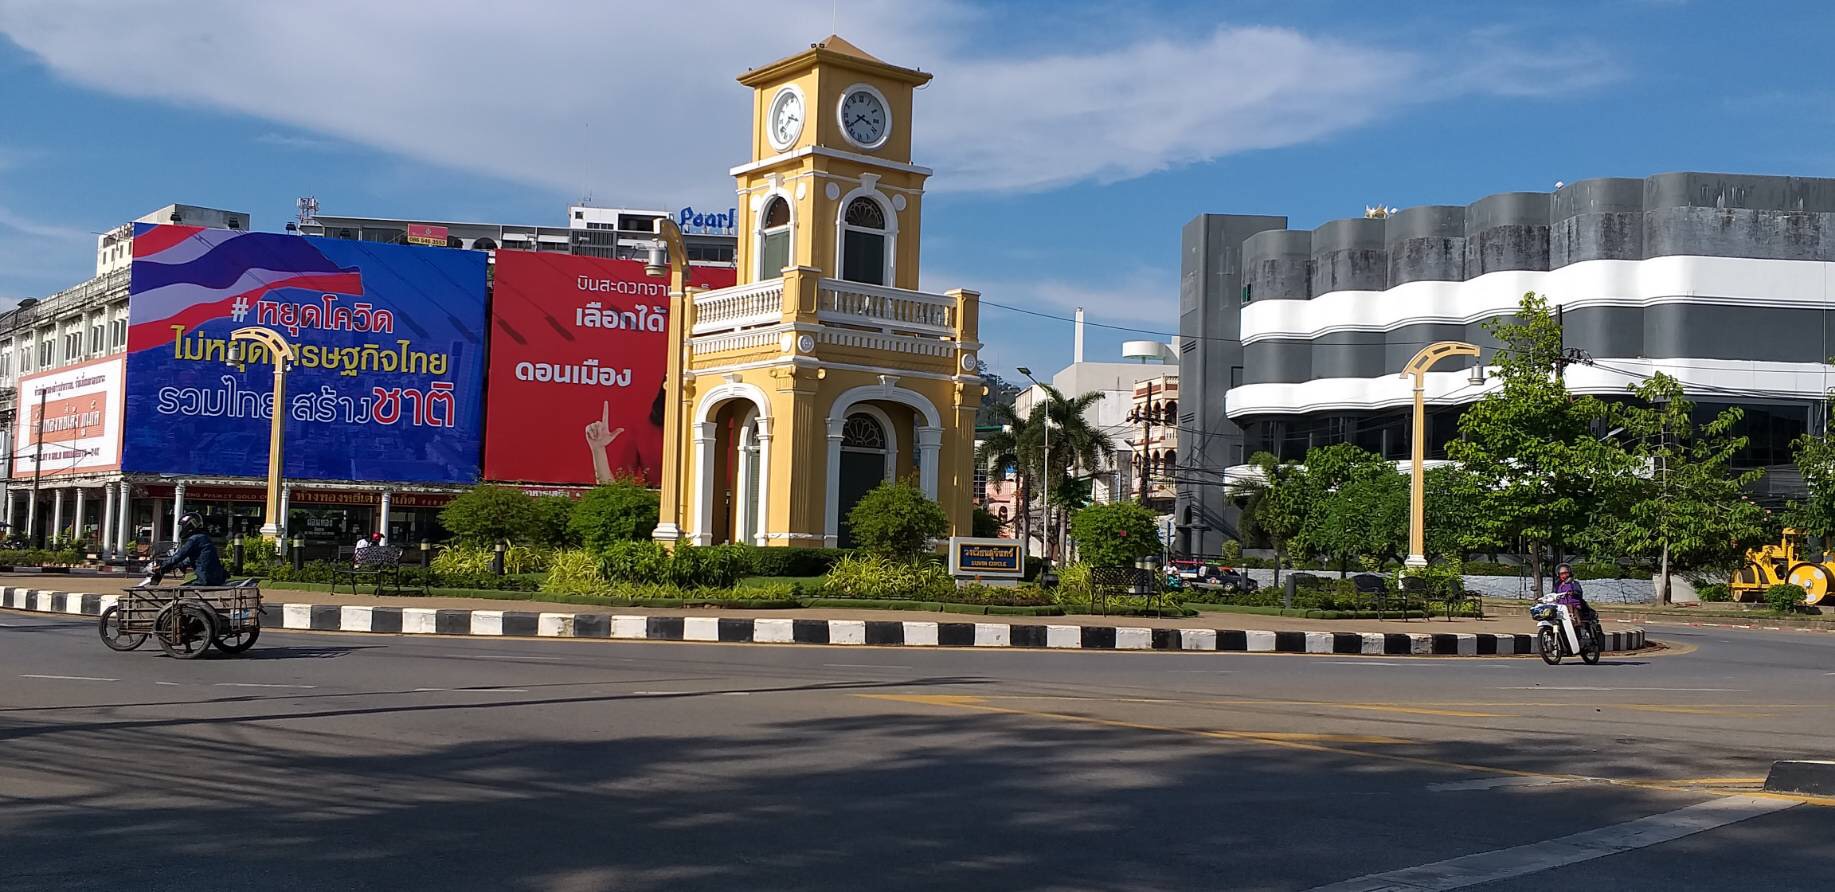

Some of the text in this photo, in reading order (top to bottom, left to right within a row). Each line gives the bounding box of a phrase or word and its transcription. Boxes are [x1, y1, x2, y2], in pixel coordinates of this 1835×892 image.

[679, 206, 736, 229] Pearl
[257, 295, 394, 337] หยุดโควิด
[575, 301, 667, 332] เลือกได้
[515, 358, 631, 387] ดอนเมือง
